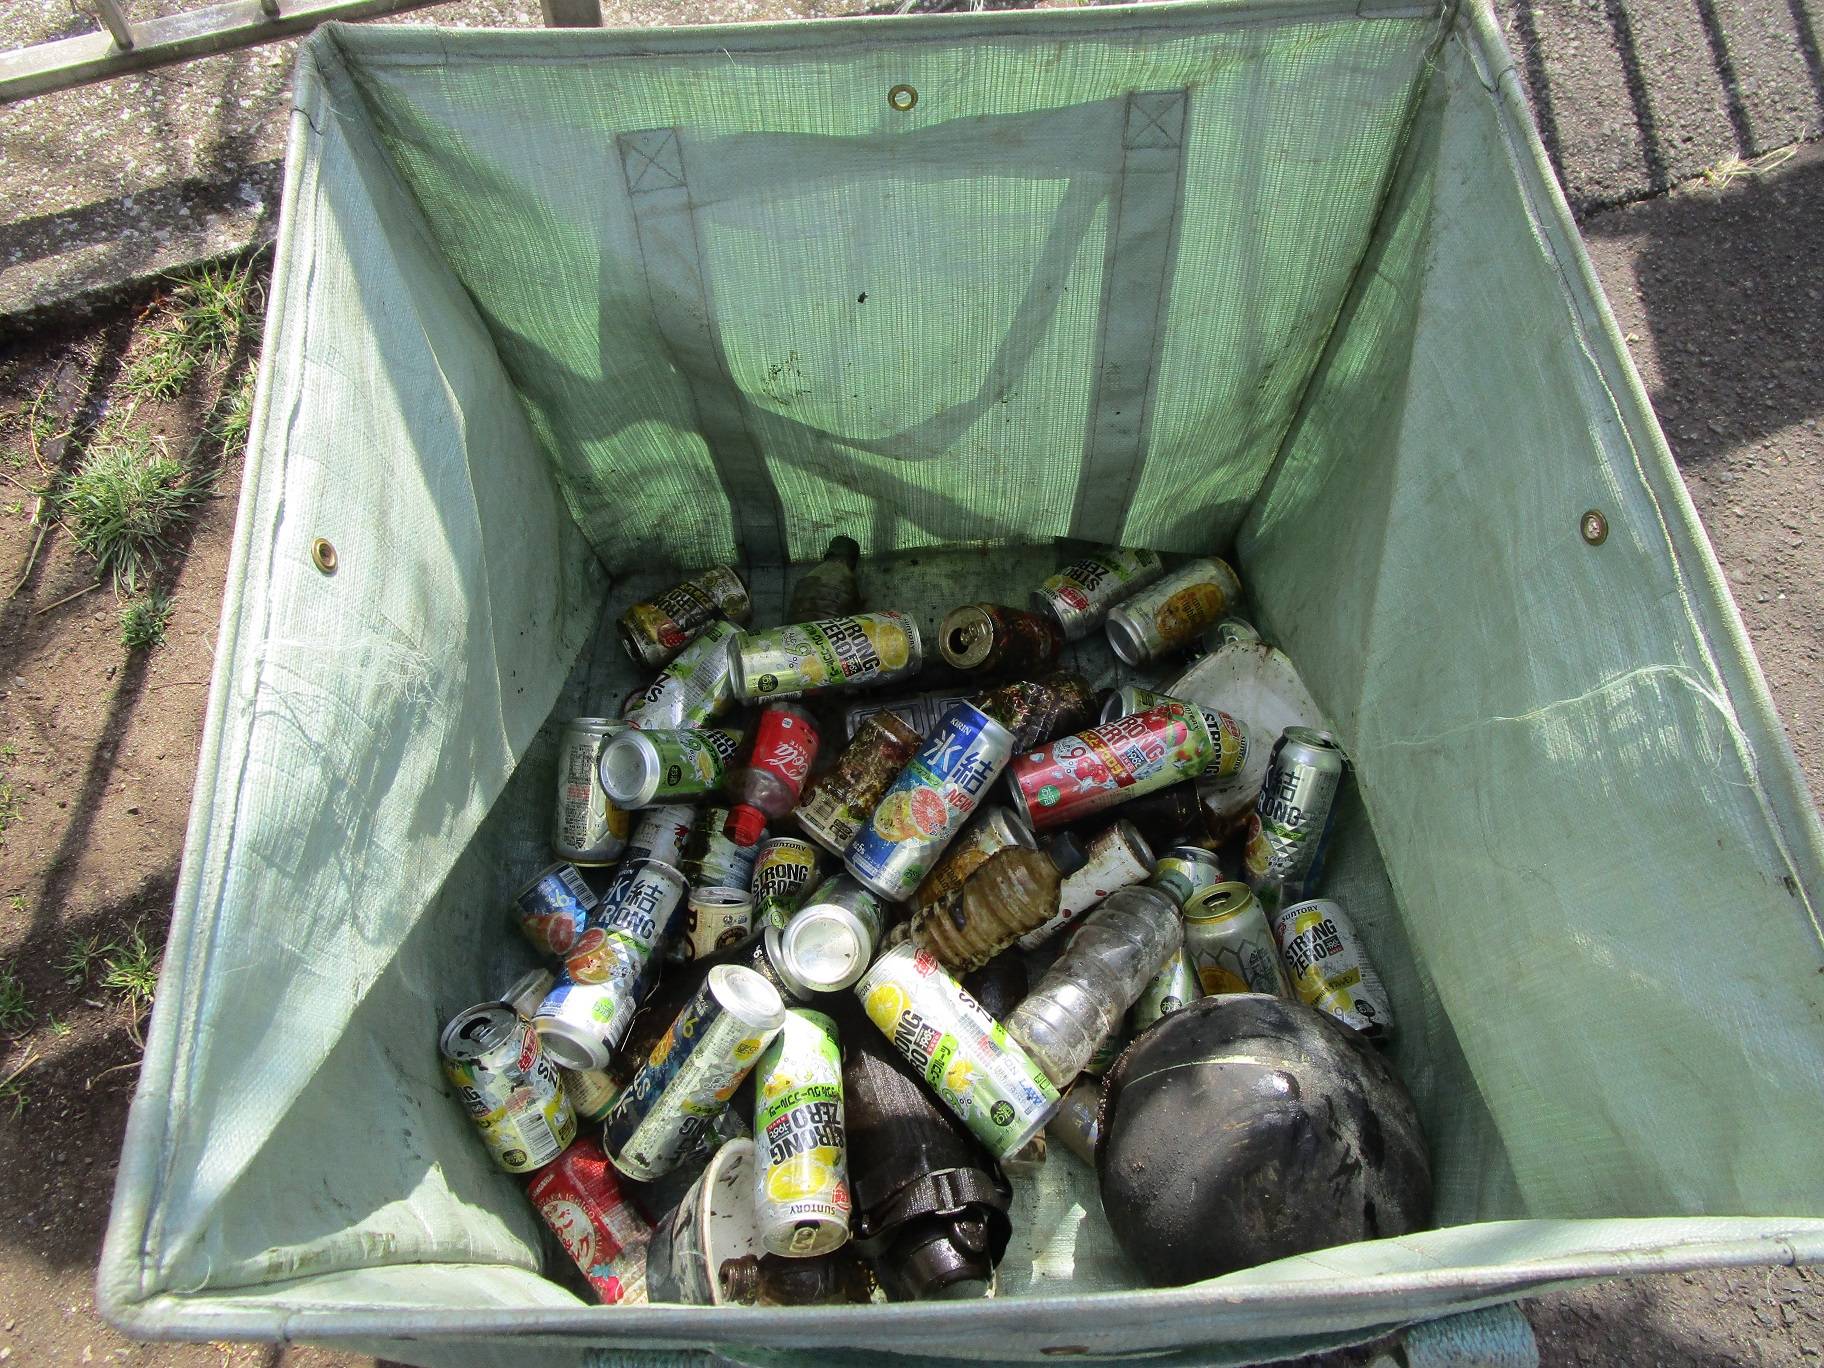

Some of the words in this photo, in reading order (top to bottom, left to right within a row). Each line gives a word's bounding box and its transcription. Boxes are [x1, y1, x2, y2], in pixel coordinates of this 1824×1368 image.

[816, 619, 852, 656] ZERO
[949, 717, 973, 736] KIRIN
[1115, 714, 1166, 763] TRONG
[922, 729, 995, 796] 氷結
[945, 788, 973, 813] NEW
[598, 902, 656, 940] RONG
[1281, 904, 1319, 924] SUNTORY
[1284, 918, 1338, 966] STRONG
[1292, 943, 1327, 980] ZERO
[907, 1047, 931, 1076] RO
[929, 1044, 951, 1087] レープフルーツ
[790, 1099, 840, 1131] ZERO
[991, 1100, 1014, 1125] お酒
[768, 1126, 845, 1166] STRONG
[789, 1204, 835, 1214] SUNTORY
